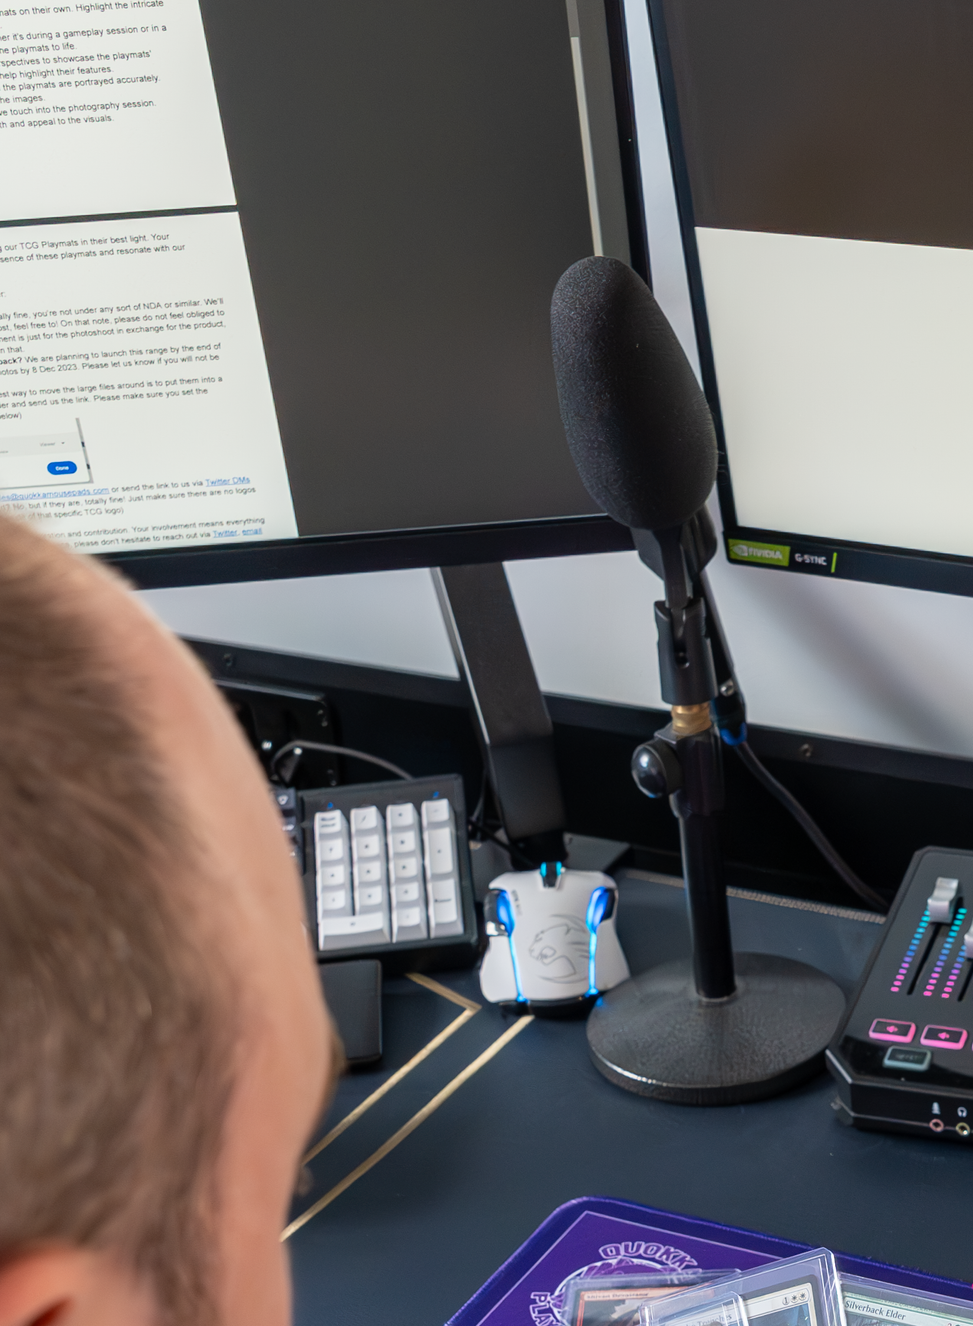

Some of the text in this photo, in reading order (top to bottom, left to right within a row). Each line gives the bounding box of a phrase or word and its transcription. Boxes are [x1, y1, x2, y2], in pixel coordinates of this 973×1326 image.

[12, 32, 24, 40] it's
[25, 31, 53, 40] during
[62, 28, 103, 39] gameplay
[105, 26, 138, 35] session
[140, 25, 149, 33] or
[41, 56, 50, 64] to
[52, 54, 94, 63] showcase
[96, 52, 110, 60] the
[112, 49, 151, 61] playmats'
[2, 83, 16, 91] the
[17, 80, 56, 91] playmats
[73, 76, 114, 88] portrayed
[18, 241, 39, 249] TCG
[40, 239, 79, 249] Playmats
[89, 237, 107, 245] their
[109, 235, 128, 244] best
[794, 553, 828, 566] G-SYNC
[844, 1300, 906, 1321] Silverback Elder
